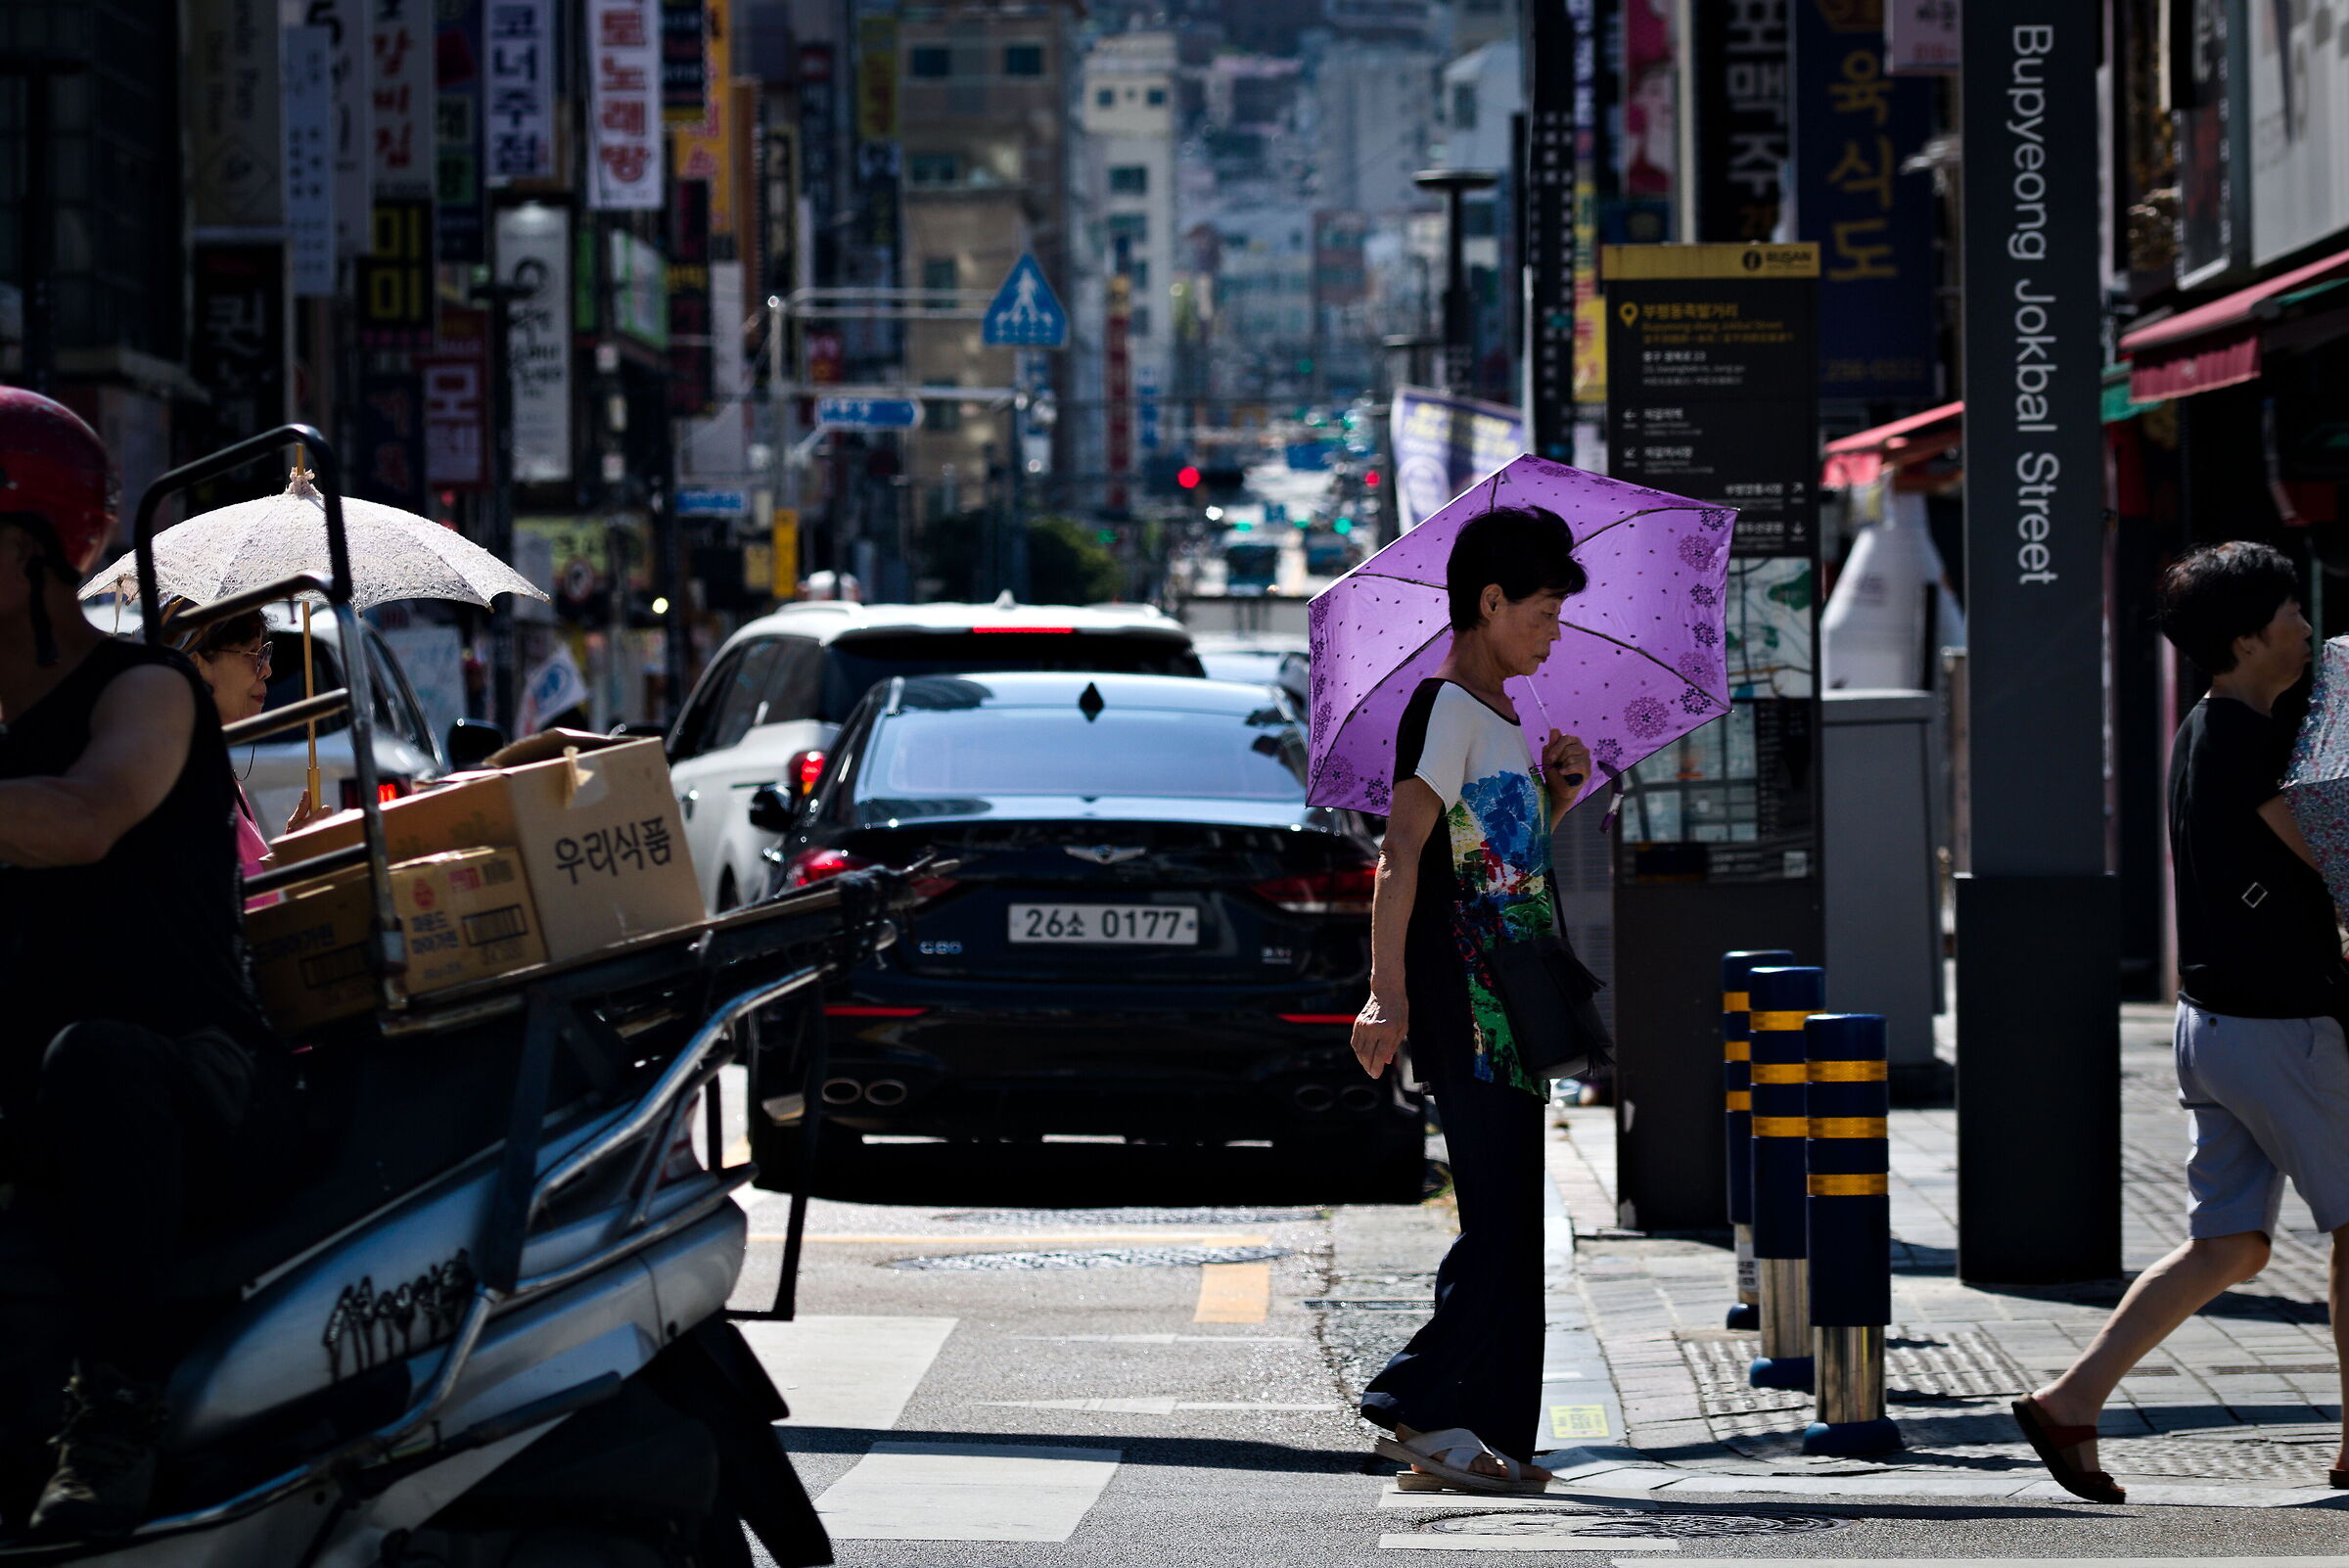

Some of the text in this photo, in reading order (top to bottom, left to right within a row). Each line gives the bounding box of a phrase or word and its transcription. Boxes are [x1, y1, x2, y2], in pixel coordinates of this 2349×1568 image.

[599, 0, 650, 183] 토노래방
[1767, 251, 1812, 262] BUSAN
[2005, 23, 2060, 585] Bupyeong Jokbal Street
[555, 816, 671, 885] 우리식품
[1026, 908, 1181, 940] 26소 0177
